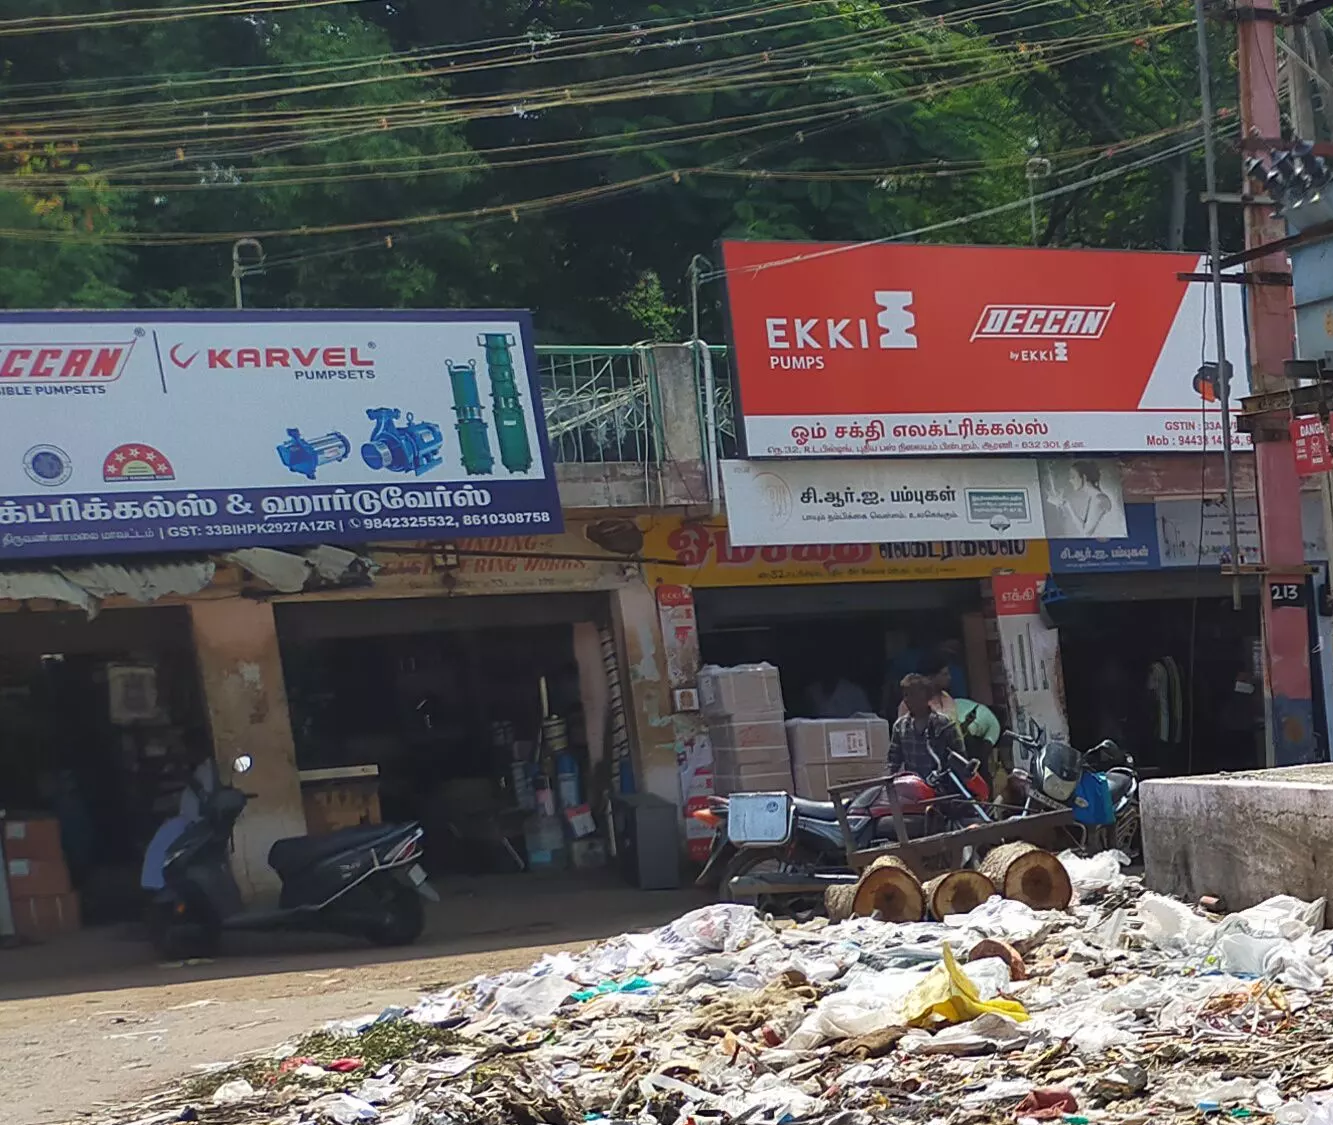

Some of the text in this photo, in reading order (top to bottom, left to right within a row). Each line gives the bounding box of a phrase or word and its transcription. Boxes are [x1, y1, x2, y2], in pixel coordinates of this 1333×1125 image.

[981, 309, 1104, 334] DECCAN
[765, 318, 869, 349] EKKI
[208, 347, 374, 369] KARVEL
[770, 356, 825, 370] PUMPS
[1021, 350, 1054, 362] EKKI
[295, 369, 376, 380] PUMPSETS
[36, 385, 106, 396] PUMPSETS
[791, 417, 1049, 446] ஓம் சக்தி எலக்ட்ரிக்கல்ஸ்
[1164, 421, 1195, 431] GSTIN
[1146, 434, 1169, 446] Mob
[226, 494, 254, 515] &
[263, 484, 491, 520] ஹார்டுவேர்ஸ்
[800, 486, 885, 507] சி.ஆர்.ஐ.
[890, 486, 957, 504] பம்புகள்
[168, 525, 202, 538] GST:
[462, 511, 550, 526] 8610308758
[1271, 584, 1298, 600] 213
